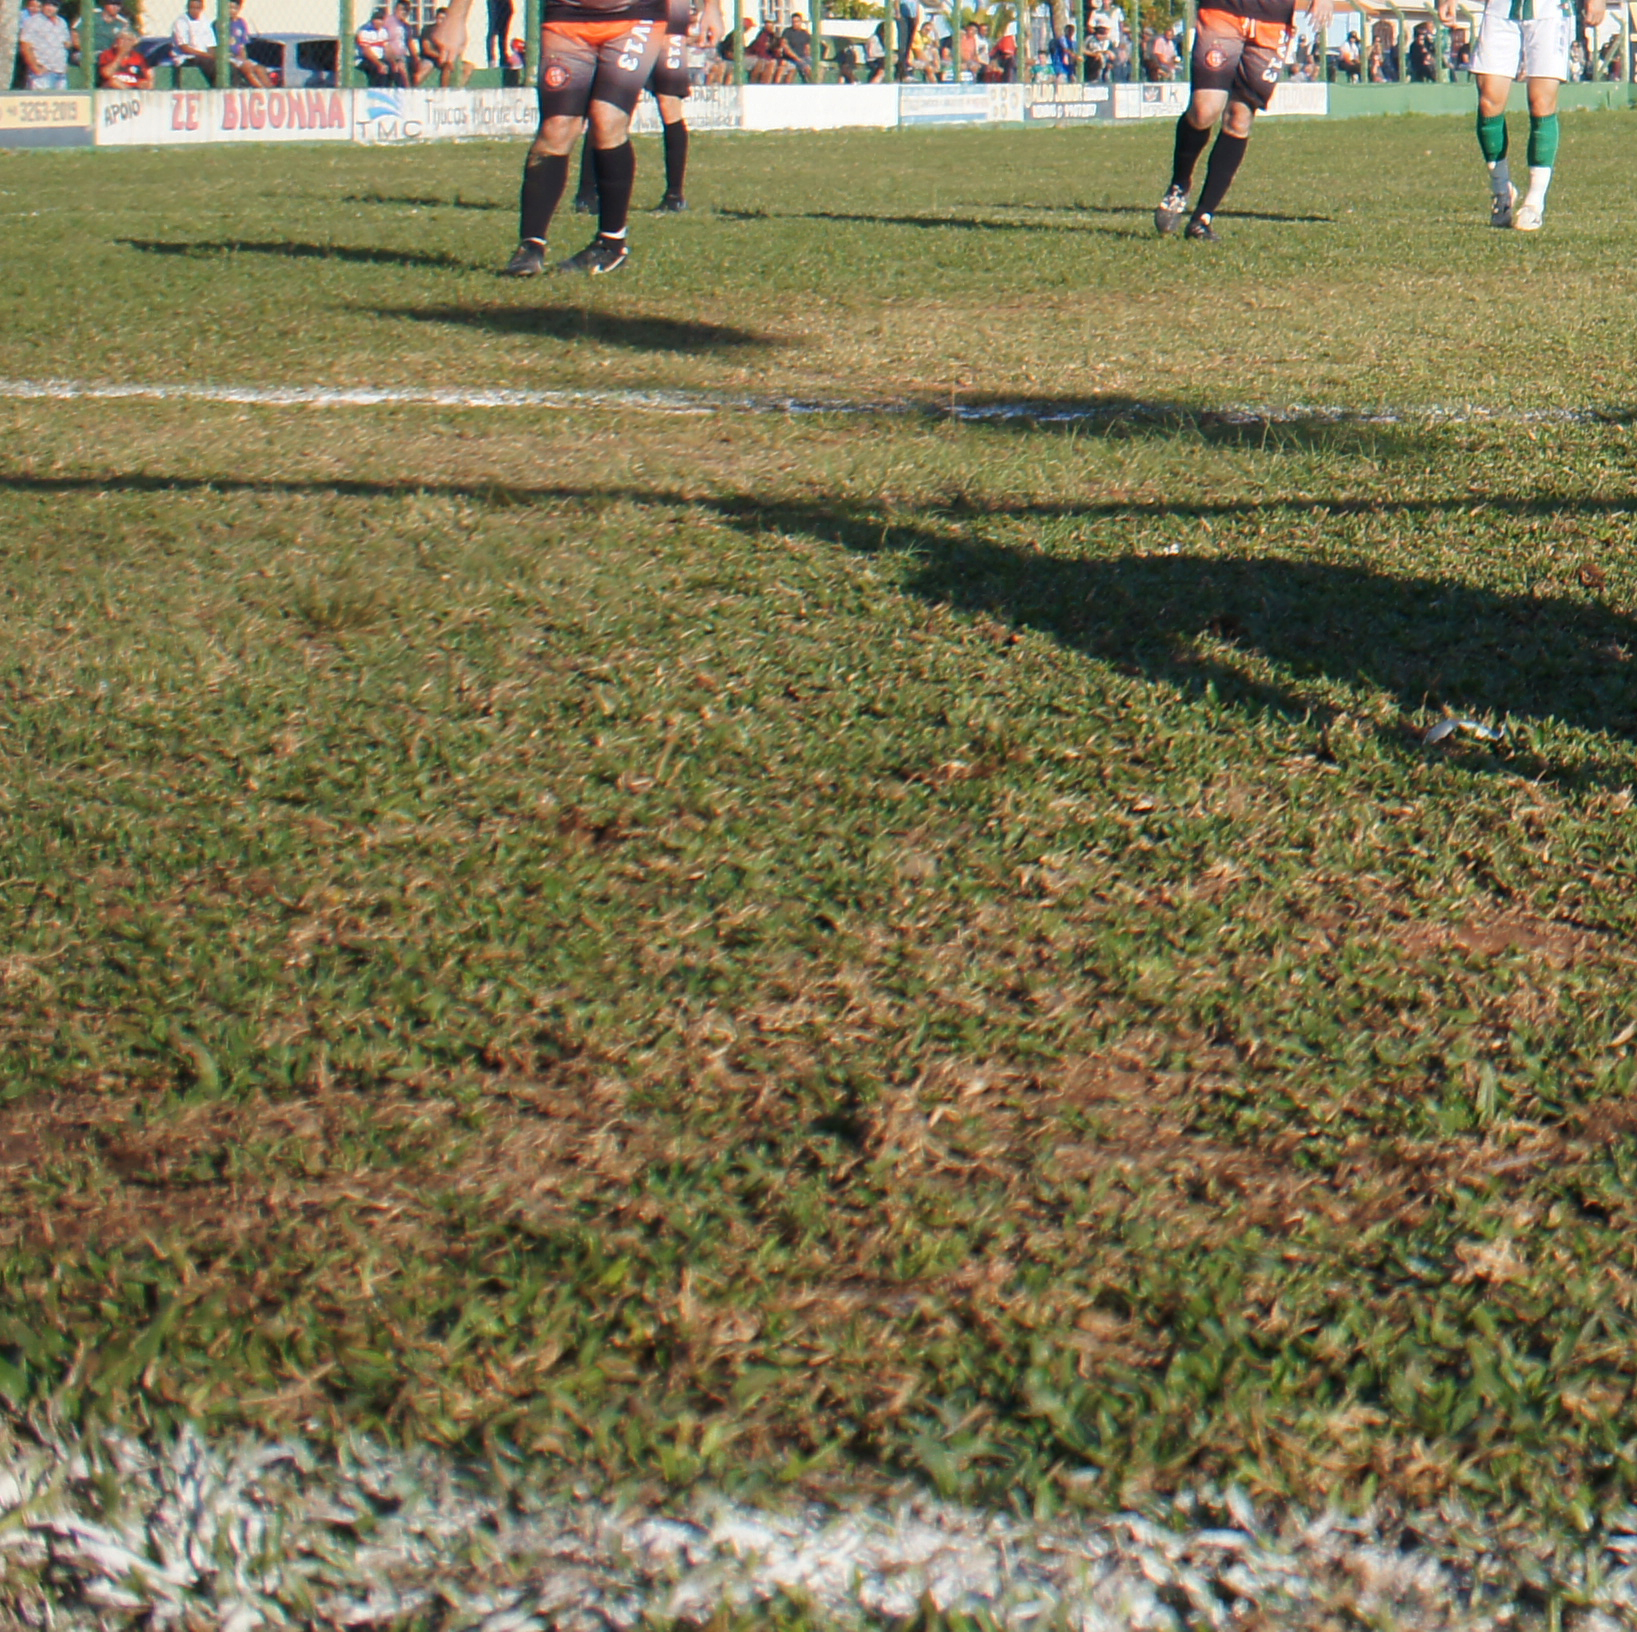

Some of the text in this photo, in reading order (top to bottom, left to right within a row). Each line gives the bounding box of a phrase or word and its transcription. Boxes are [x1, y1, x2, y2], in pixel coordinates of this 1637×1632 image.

[666, 35, 685, 70] V13
[104, 99, 140, 126] APOIO
[222, 90, 346, 130] BIGONHA
[356, 119, 424, 139] TMC
